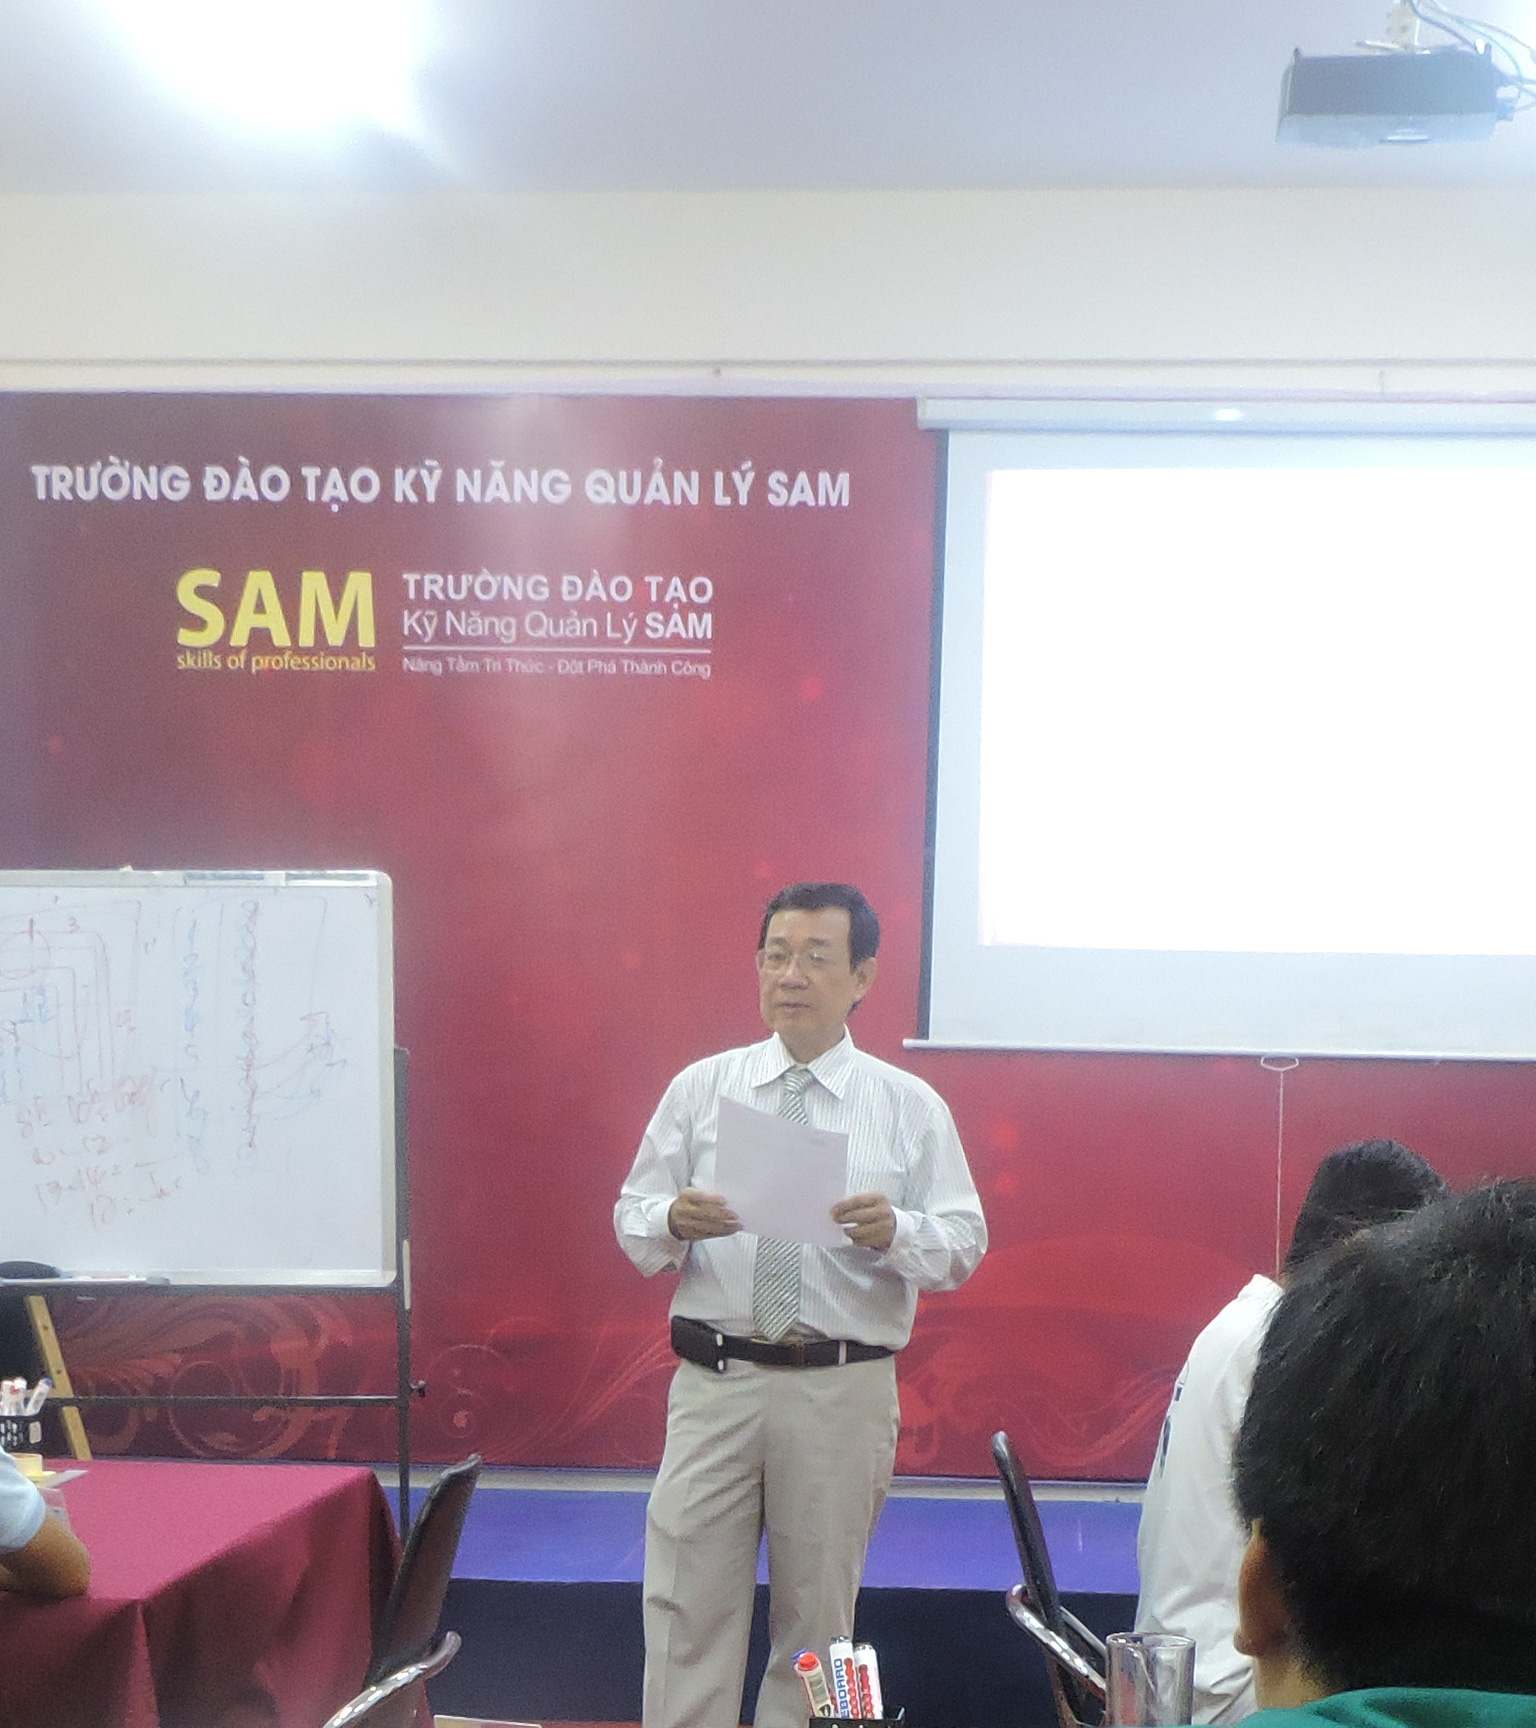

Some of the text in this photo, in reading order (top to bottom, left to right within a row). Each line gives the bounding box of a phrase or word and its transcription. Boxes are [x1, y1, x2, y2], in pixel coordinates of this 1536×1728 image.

[31, 455, 850, 513] TRƯỜNG ĐÀO TẠO KỸ NĂNG QUẢN LÝ SAM
[176, 567, 376, 648] SAM
[402, 568, 713, 610] TRƯỜNG ĐÀO TẠO
[402, 609, 712, 644] Kỹ Năng Quản Lý SAM
[176, 650, 376, 675] skills of professionals
